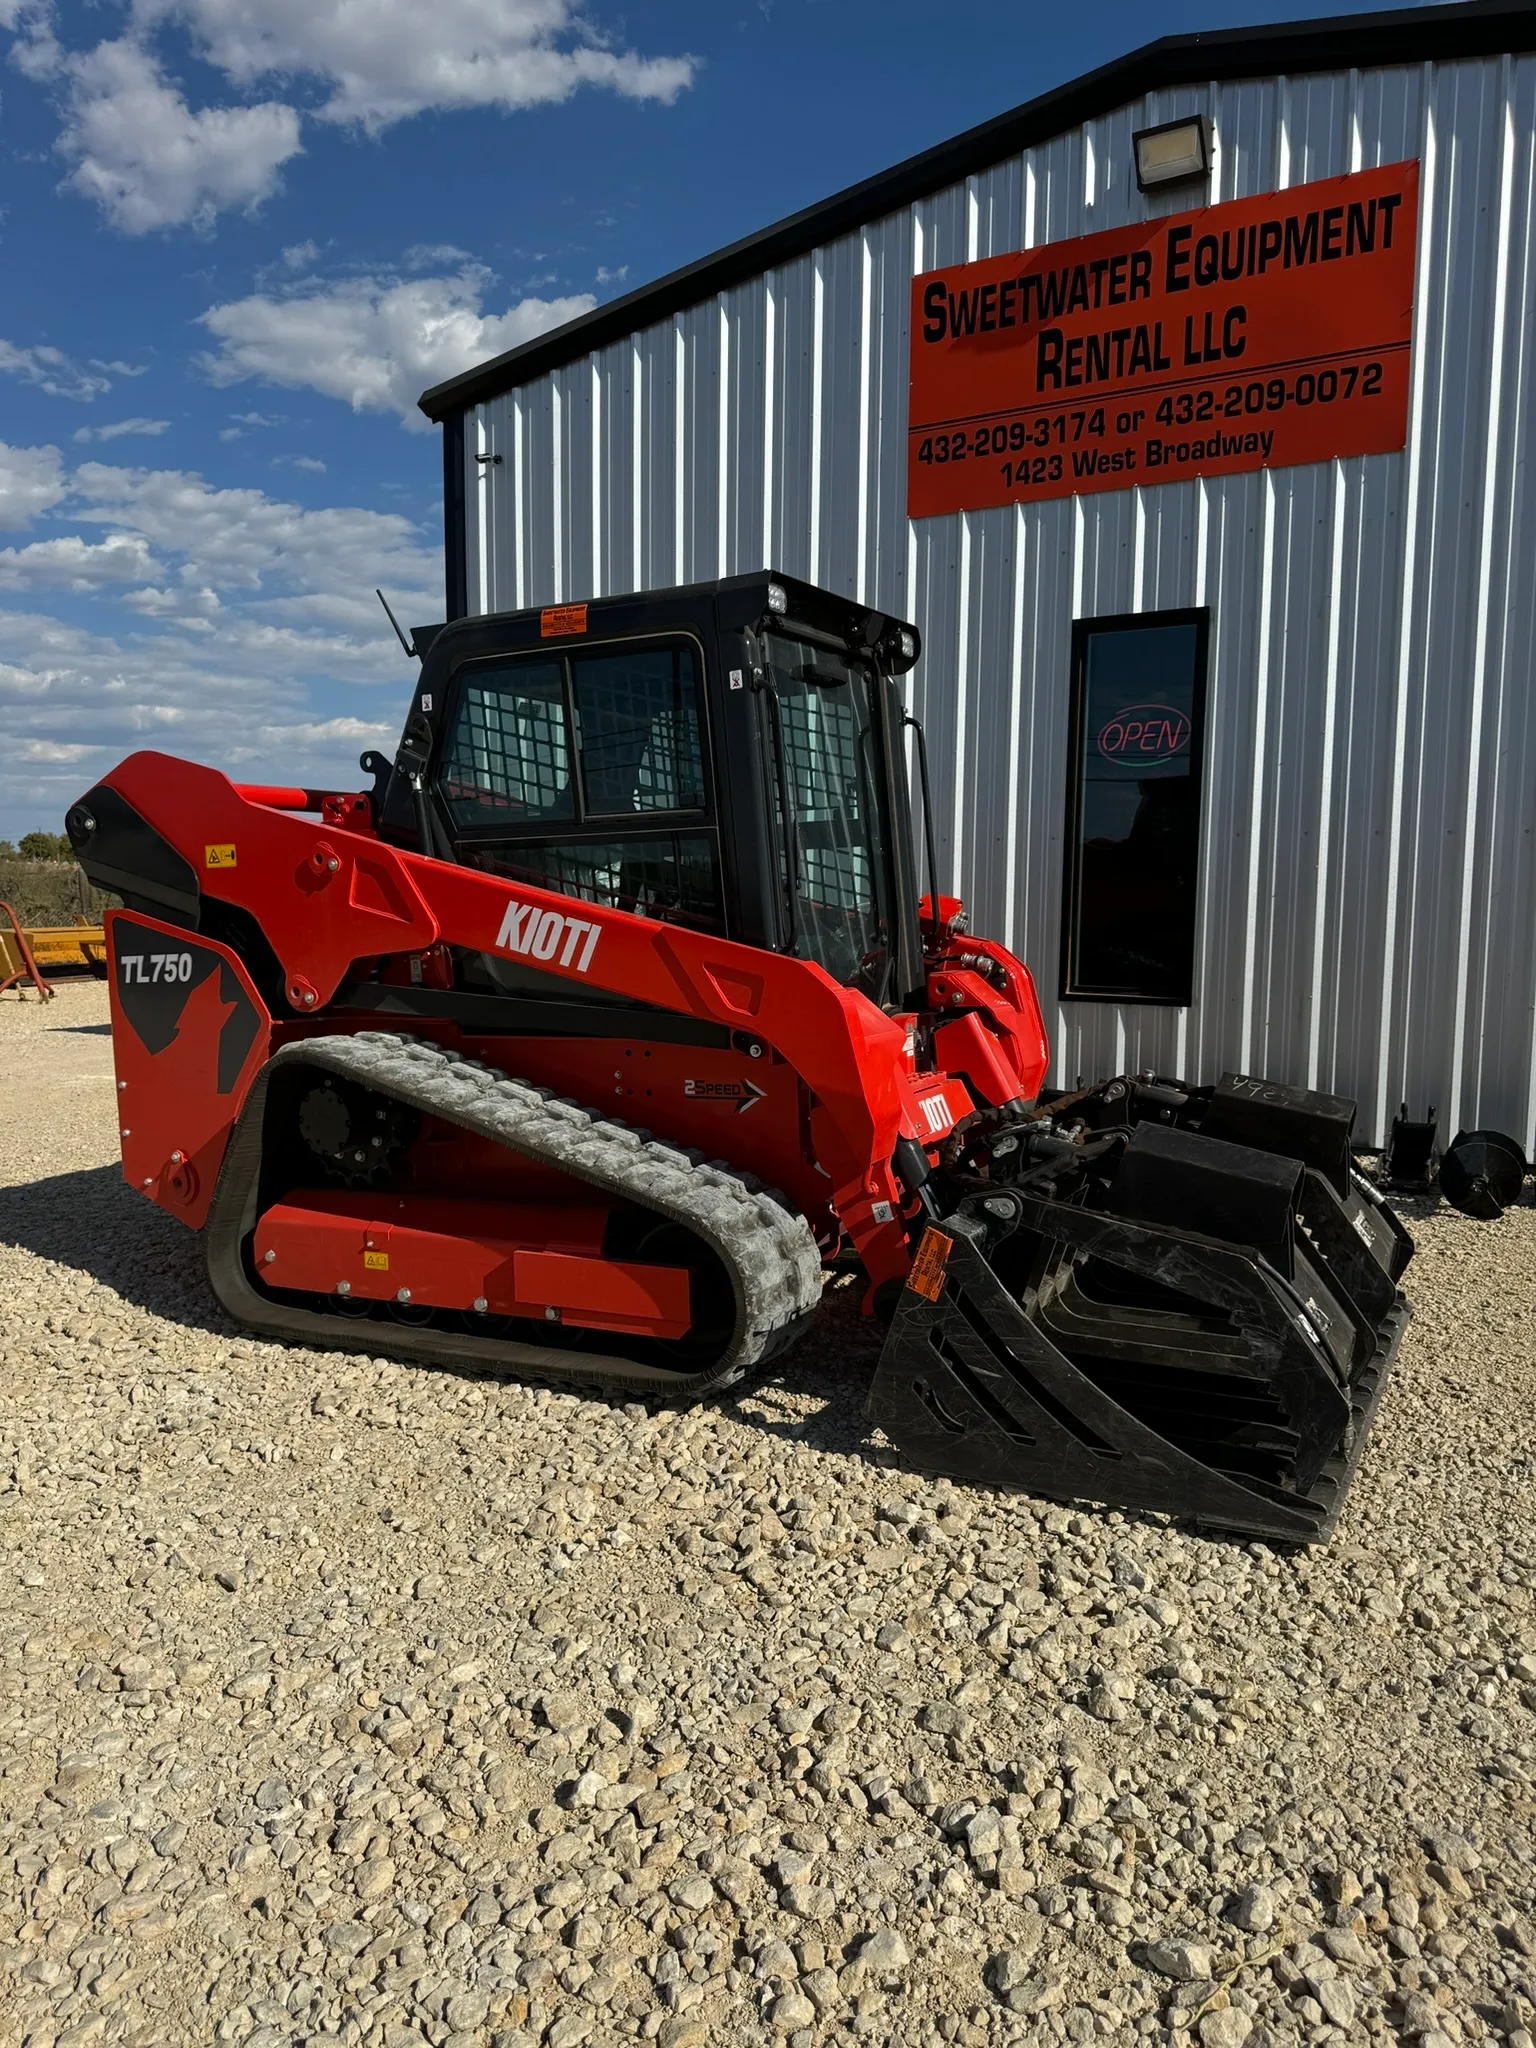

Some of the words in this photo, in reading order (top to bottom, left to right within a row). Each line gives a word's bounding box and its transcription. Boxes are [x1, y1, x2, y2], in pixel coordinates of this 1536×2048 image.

[1183, 305, 1247, 366] LLC
[917, 408, 1105, 466] 432-209-3174
[1115, 409, 1146, 435] or
[1155, 362, 1383, 427] 432-209-0072
[1000, 455, 1063, 488] 1423
[1071, 447, 1137, 478] West
[1145, 429, 1274, 468] Broadway
[1102, 719, 1183, 752] OPEN
[495, 900, 603, 974] KIOTI
[120, 953, 194, 985] TL750
[918, 1093, 955, 1134] IOTI
